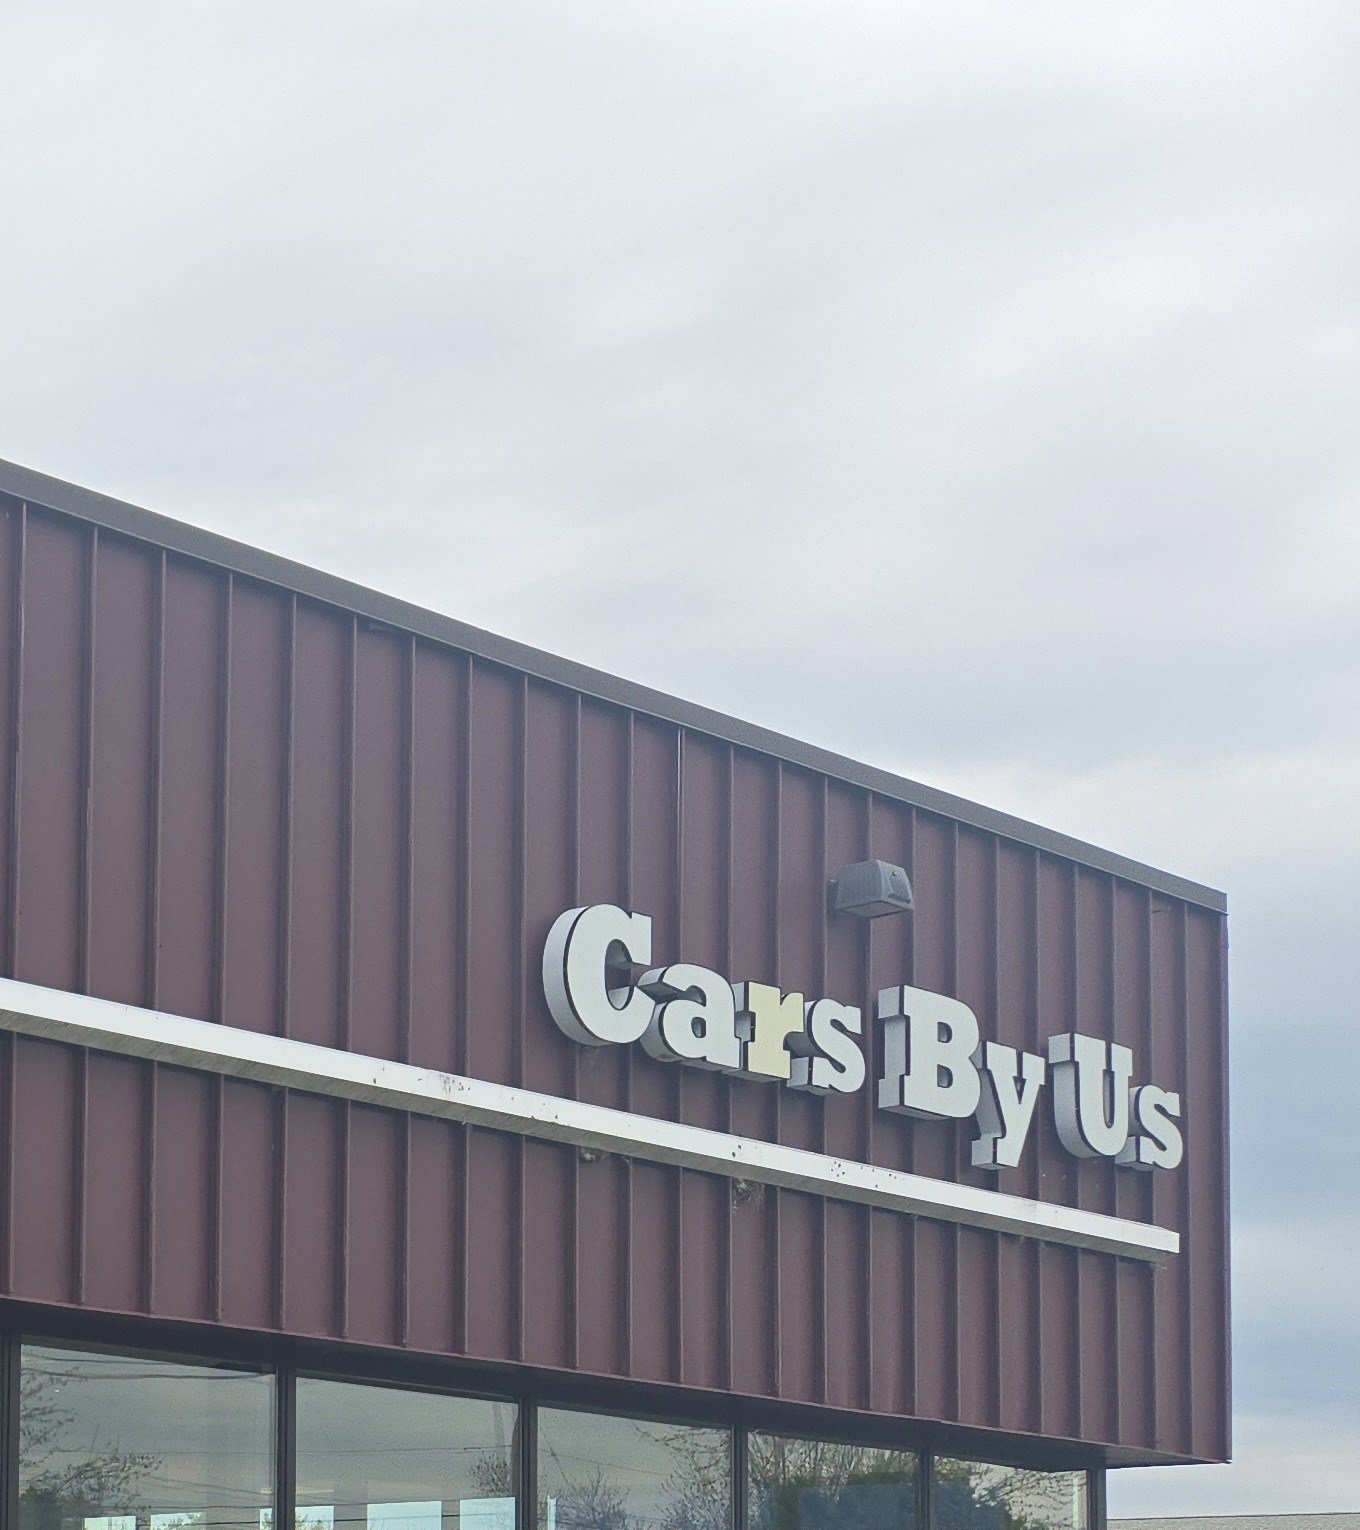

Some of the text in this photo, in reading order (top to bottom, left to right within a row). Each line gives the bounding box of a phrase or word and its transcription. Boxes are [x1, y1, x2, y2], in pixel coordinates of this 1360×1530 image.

[542, 903, 1184, 1171] Cars By Us
